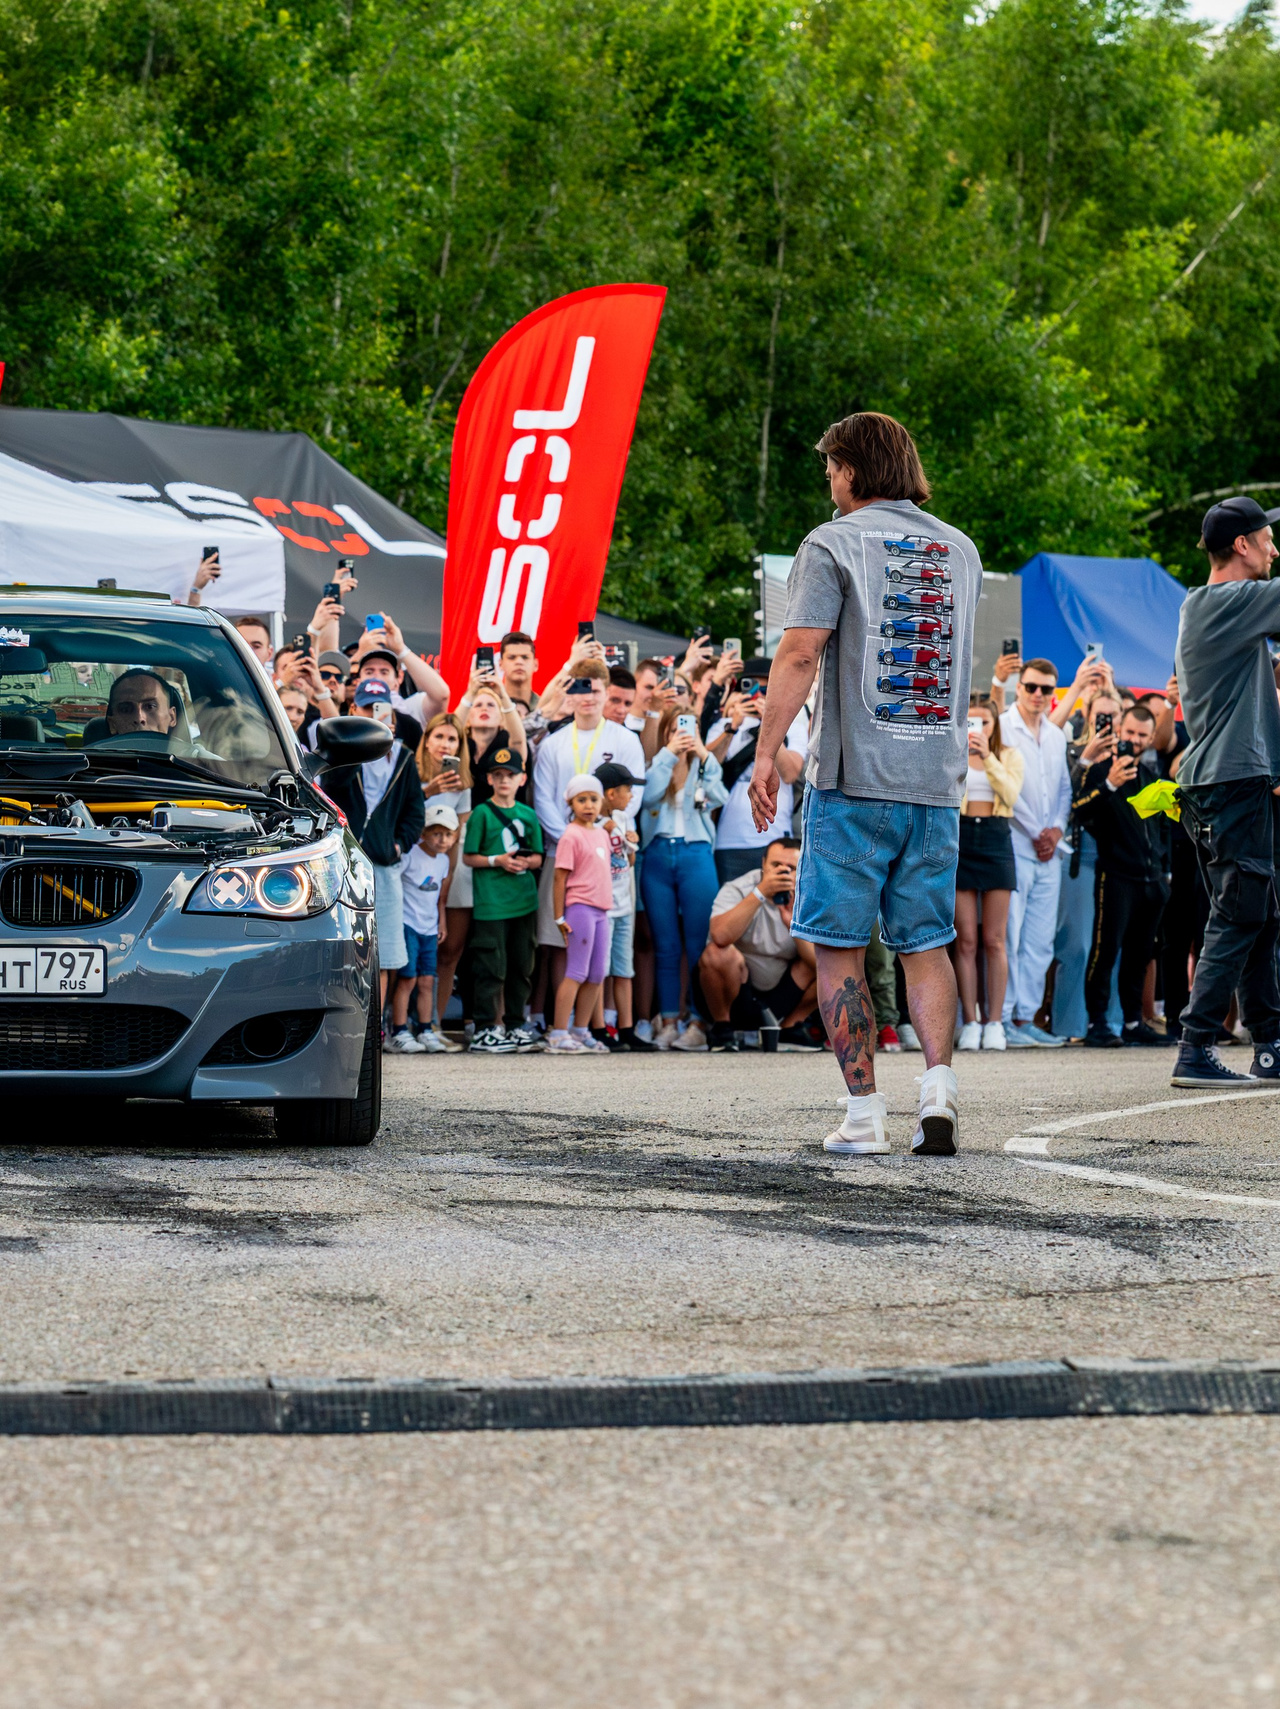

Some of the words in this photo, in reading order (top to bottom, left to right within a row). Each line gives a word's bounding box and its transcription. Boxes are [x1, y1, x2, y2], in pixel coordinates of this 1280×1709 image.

[470, 336, 597, 680] SOL
[40, 952, 95, 979] 797
[60, 980, 87, 990] RUS
